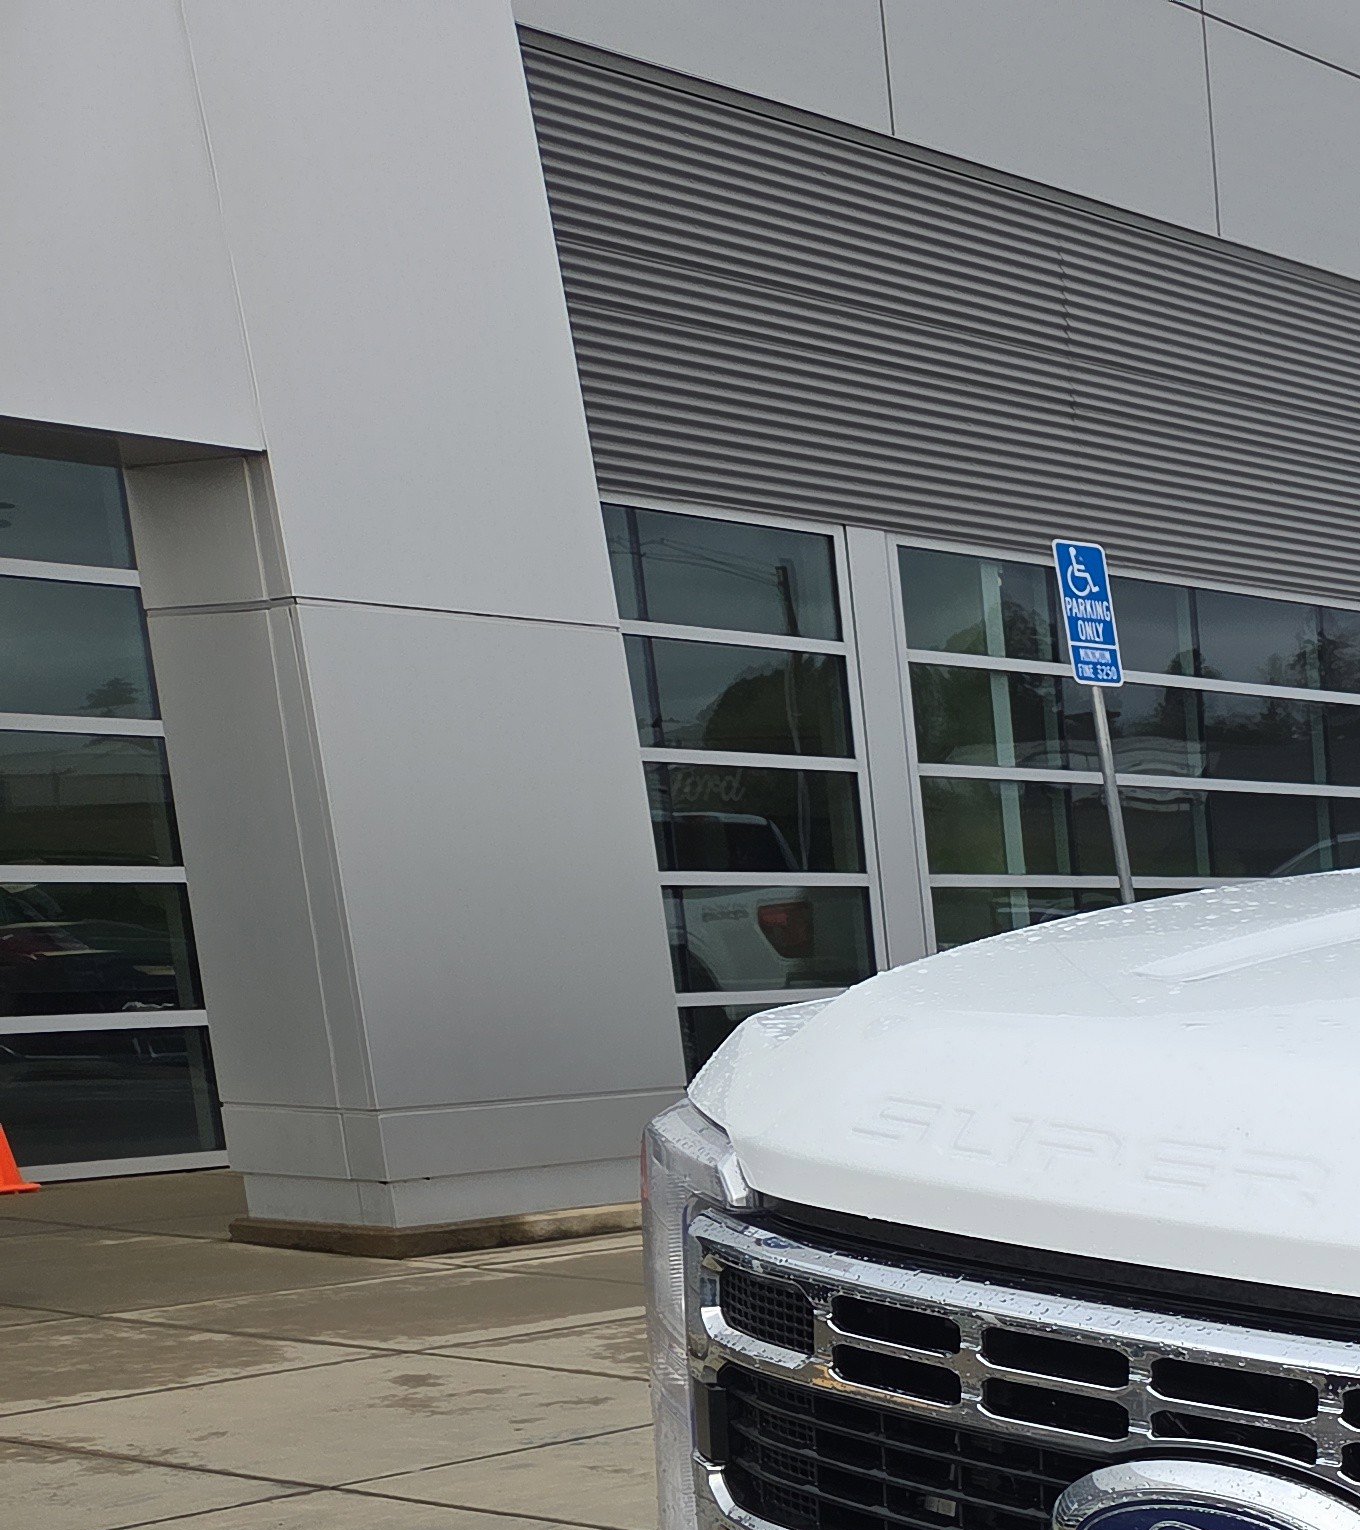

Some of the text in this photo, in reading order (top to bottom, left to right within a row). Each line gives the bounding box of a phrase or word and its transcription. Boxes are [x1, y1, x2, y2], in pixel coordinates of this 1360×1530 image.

[1065, 596, 1111, 622] PARKING
[1077, 619, 1104, 643] ONLY
[849, 1093, 1334, 1209] SUPER
